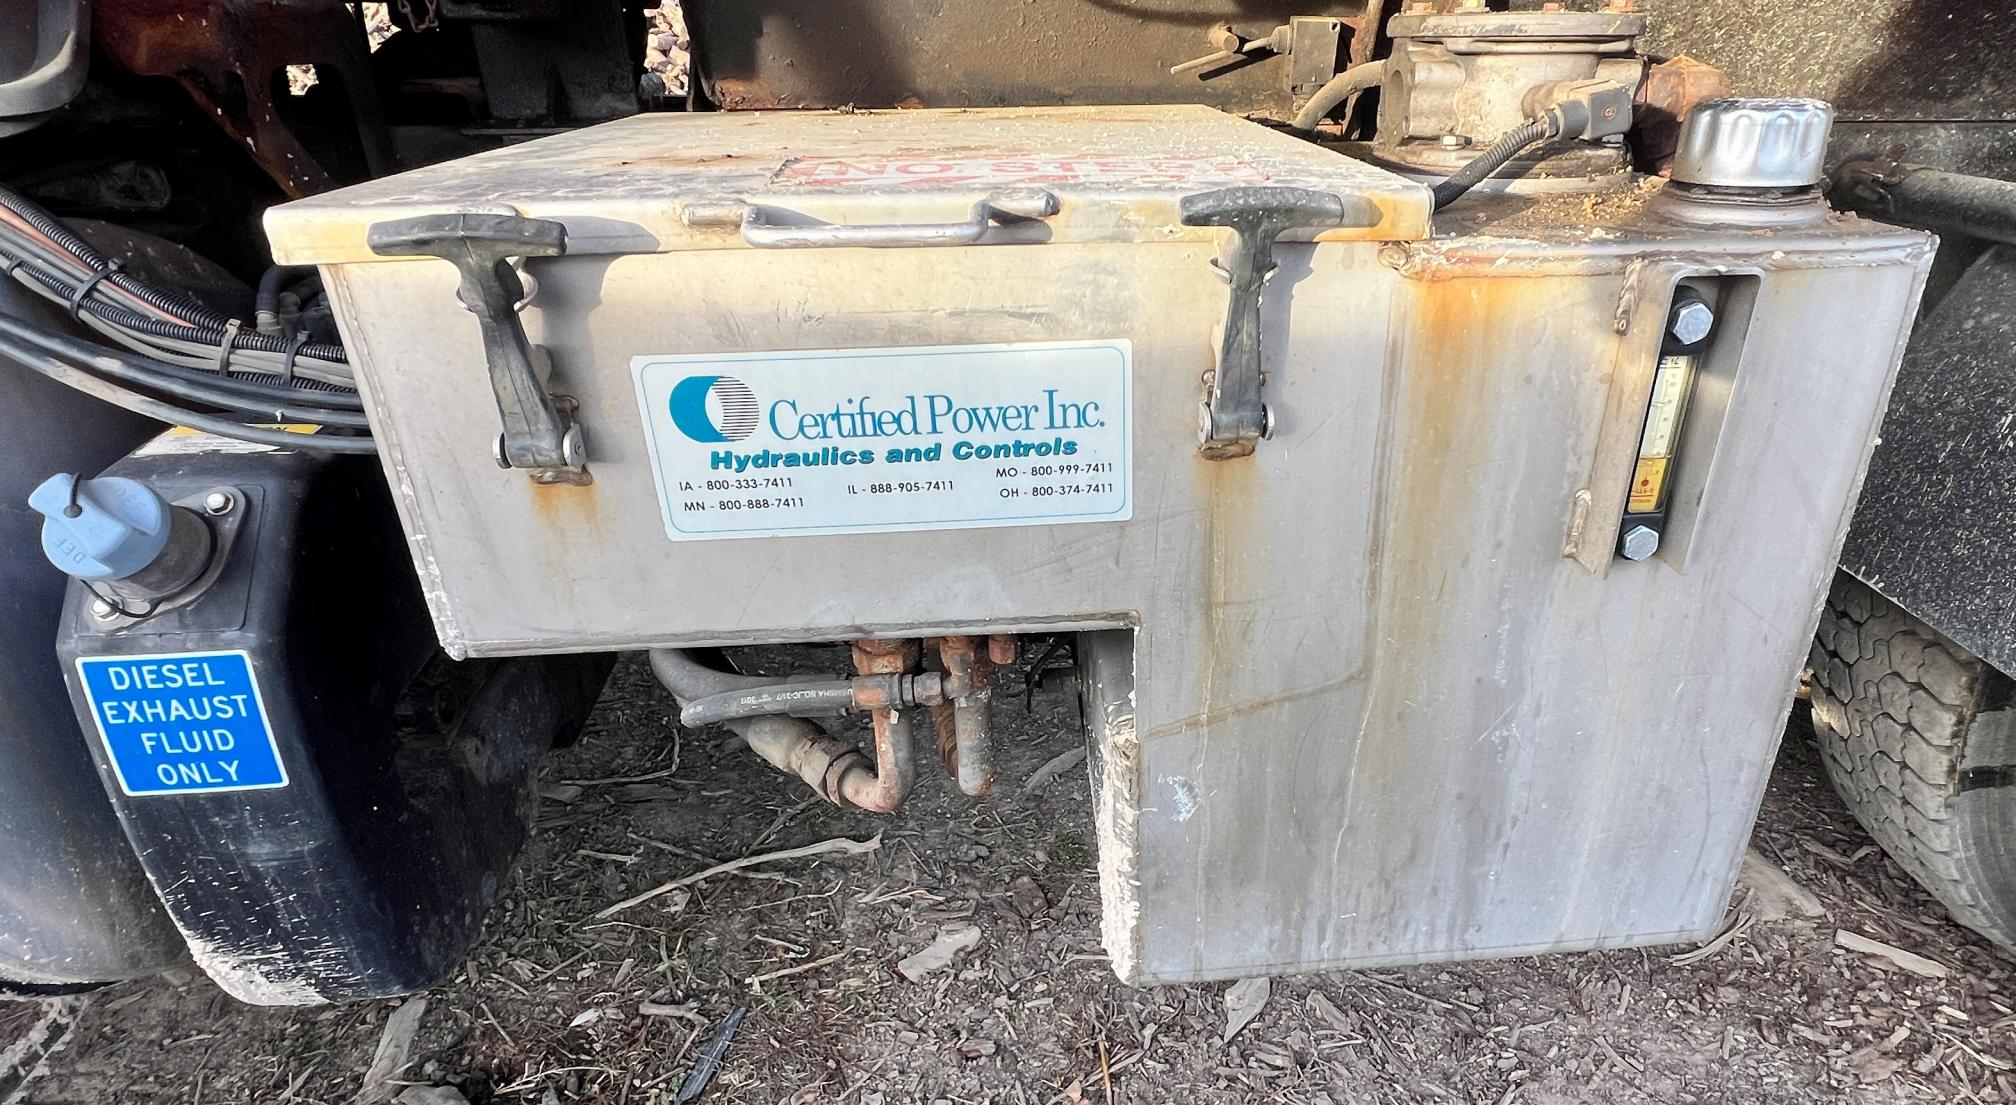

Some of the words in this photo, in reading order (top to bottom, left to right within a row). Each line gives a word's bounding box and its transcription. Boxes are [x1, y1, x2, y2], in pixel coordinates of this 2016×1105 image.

[834, 160, 954, 176] NO
[769, 395, 922, 441] Certified
[923, 393, 1040, 435] Power
[1042, 389, 1106, 429] Inc.
[710, 446, 875, 473] Hydraulics
[885, 442, 942, 464] and
[952, 437, 1078, 461] Controls
[996, 467, 1018, 478] MO
[1031, 463, 1113, 477] 800-999-7411
[679, 480, 693, 492] IA
[706, 477, 793, 491] 800-333-7411
[847, 484, 858, 495] IL
[870, 480, 954, 494] 888-905-7411
[1000, 487, 1019, 498] OH
[1032, 483, 1113, 497] 800-374-7411
[684, 500, 706, 512] MN
[718, 497, 804, 511] 800-888-7411
[52, 536, 86, 565] DEF
[107, 662, 225, 691] DIESEL
[102, 694, 248, 725] EXHAUST
[140, 728, 235, 755] FLUID
[156, 759, 240, 786] ONLY
